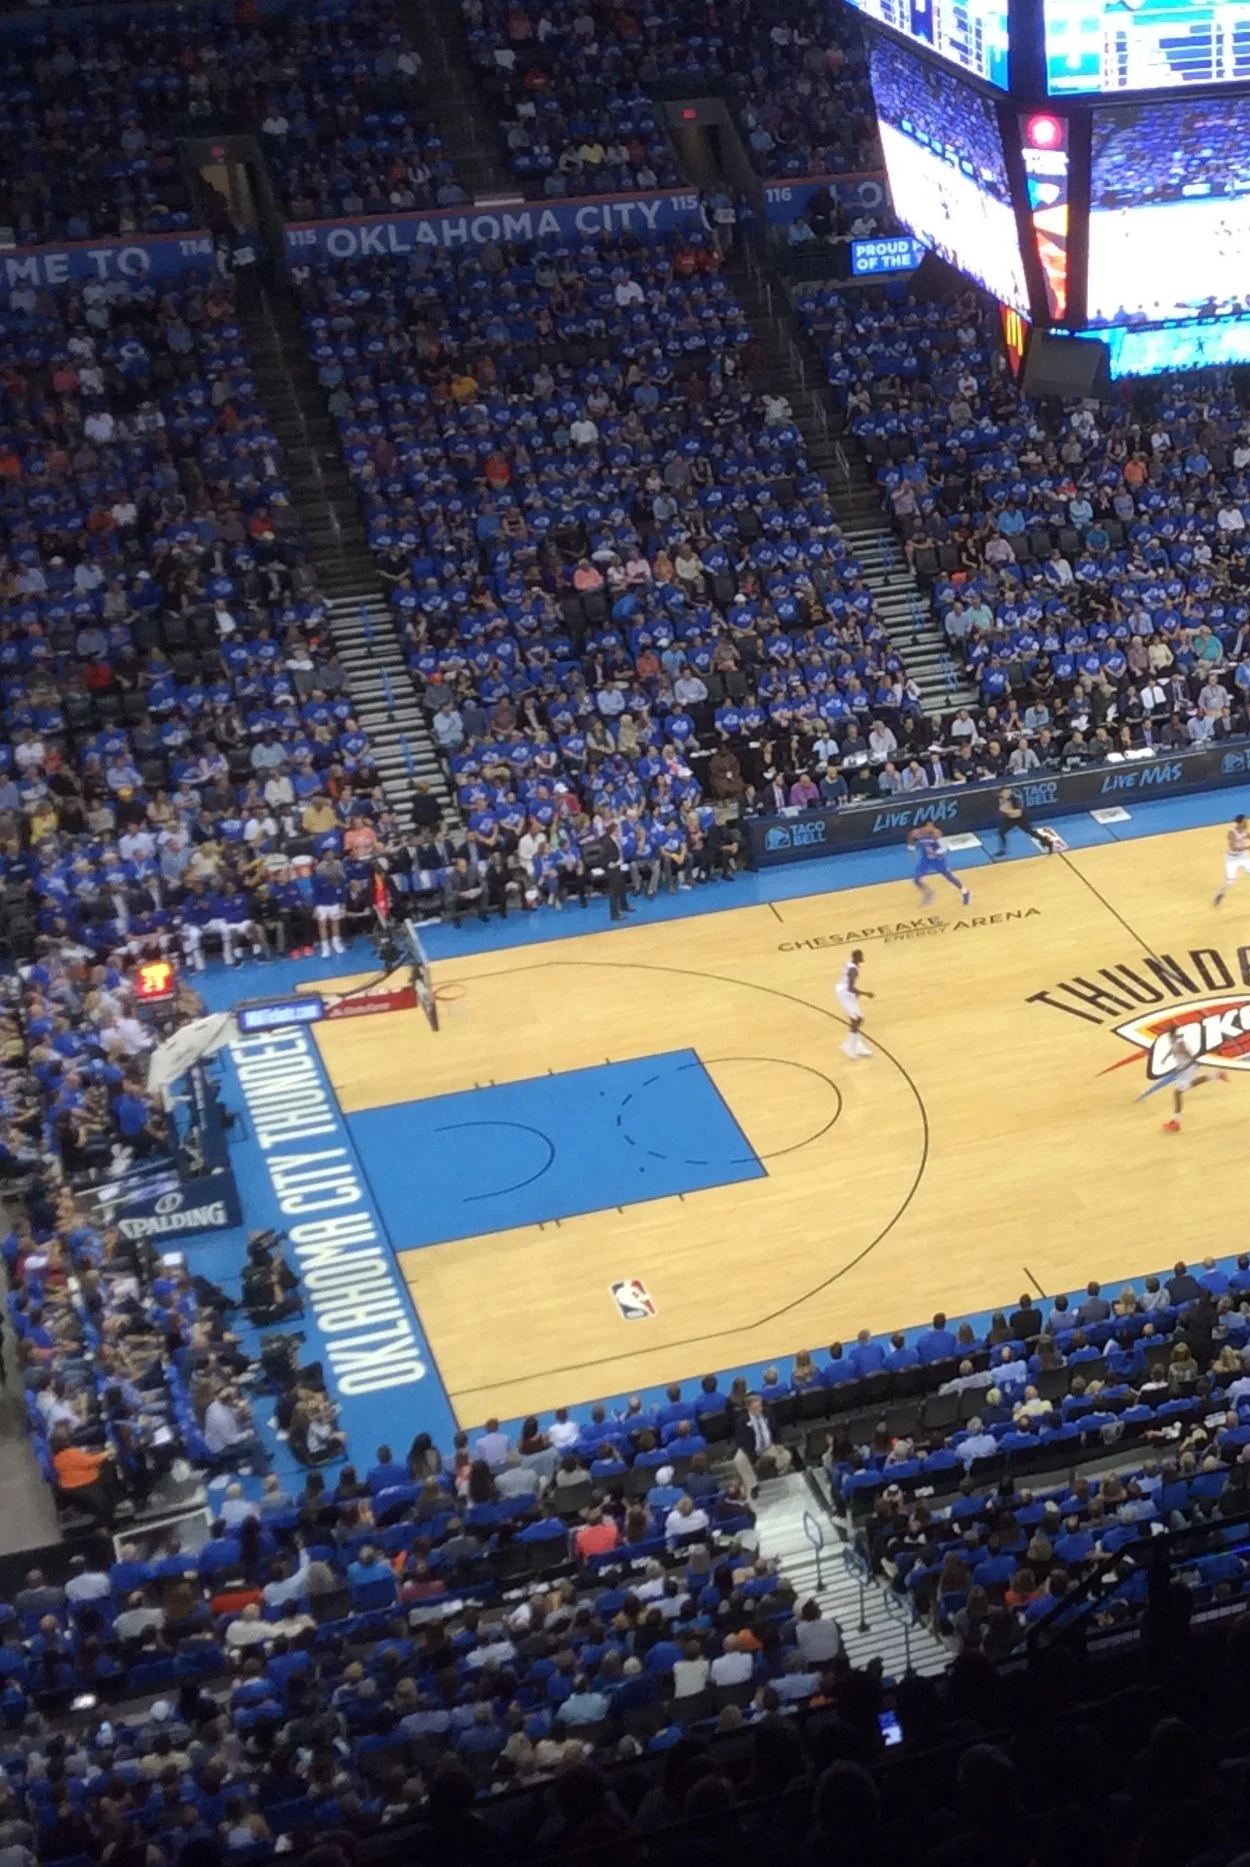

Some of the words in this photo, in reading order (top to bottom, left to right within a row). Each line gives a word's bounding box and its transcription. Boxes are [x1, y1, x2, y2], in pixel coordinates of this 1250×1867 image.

[671, 194, 698, 212] 115
[766, 187, 792, 204] 116
[287, 230, 317, 246] 115
[326, 205, 560, 258] OKLAHOMA
[575, 200, 661, 235] CITY
[856, 241, 909, 257] PROUD
[0, 253, 70, 286] ME
[88, 247, 149, 279] TO
[857, 257, 878, 270] OF
[881, 253, 911, 268] THE
[1139, 761, 1183, 787] MÁS
[1023, 782, 1057, 796] TACO
[1025, 792, 1057, 806] BELL
[913, 801, 959, 826] MÁS
[790, 820, 826, 835] TACO
[793, 832, 826, 846] BELL
[778, 916, 945, 952] CHESAPEAKE
[952, 907, 1041, 931] ARENA
[884, 926, 947, 944] ENERGY
[266, 1146, 364, 1216] CITY
[118, 1200, 228, 1239] SPALDING
[287, 1210, 427, 1396] OKLAHOMA
